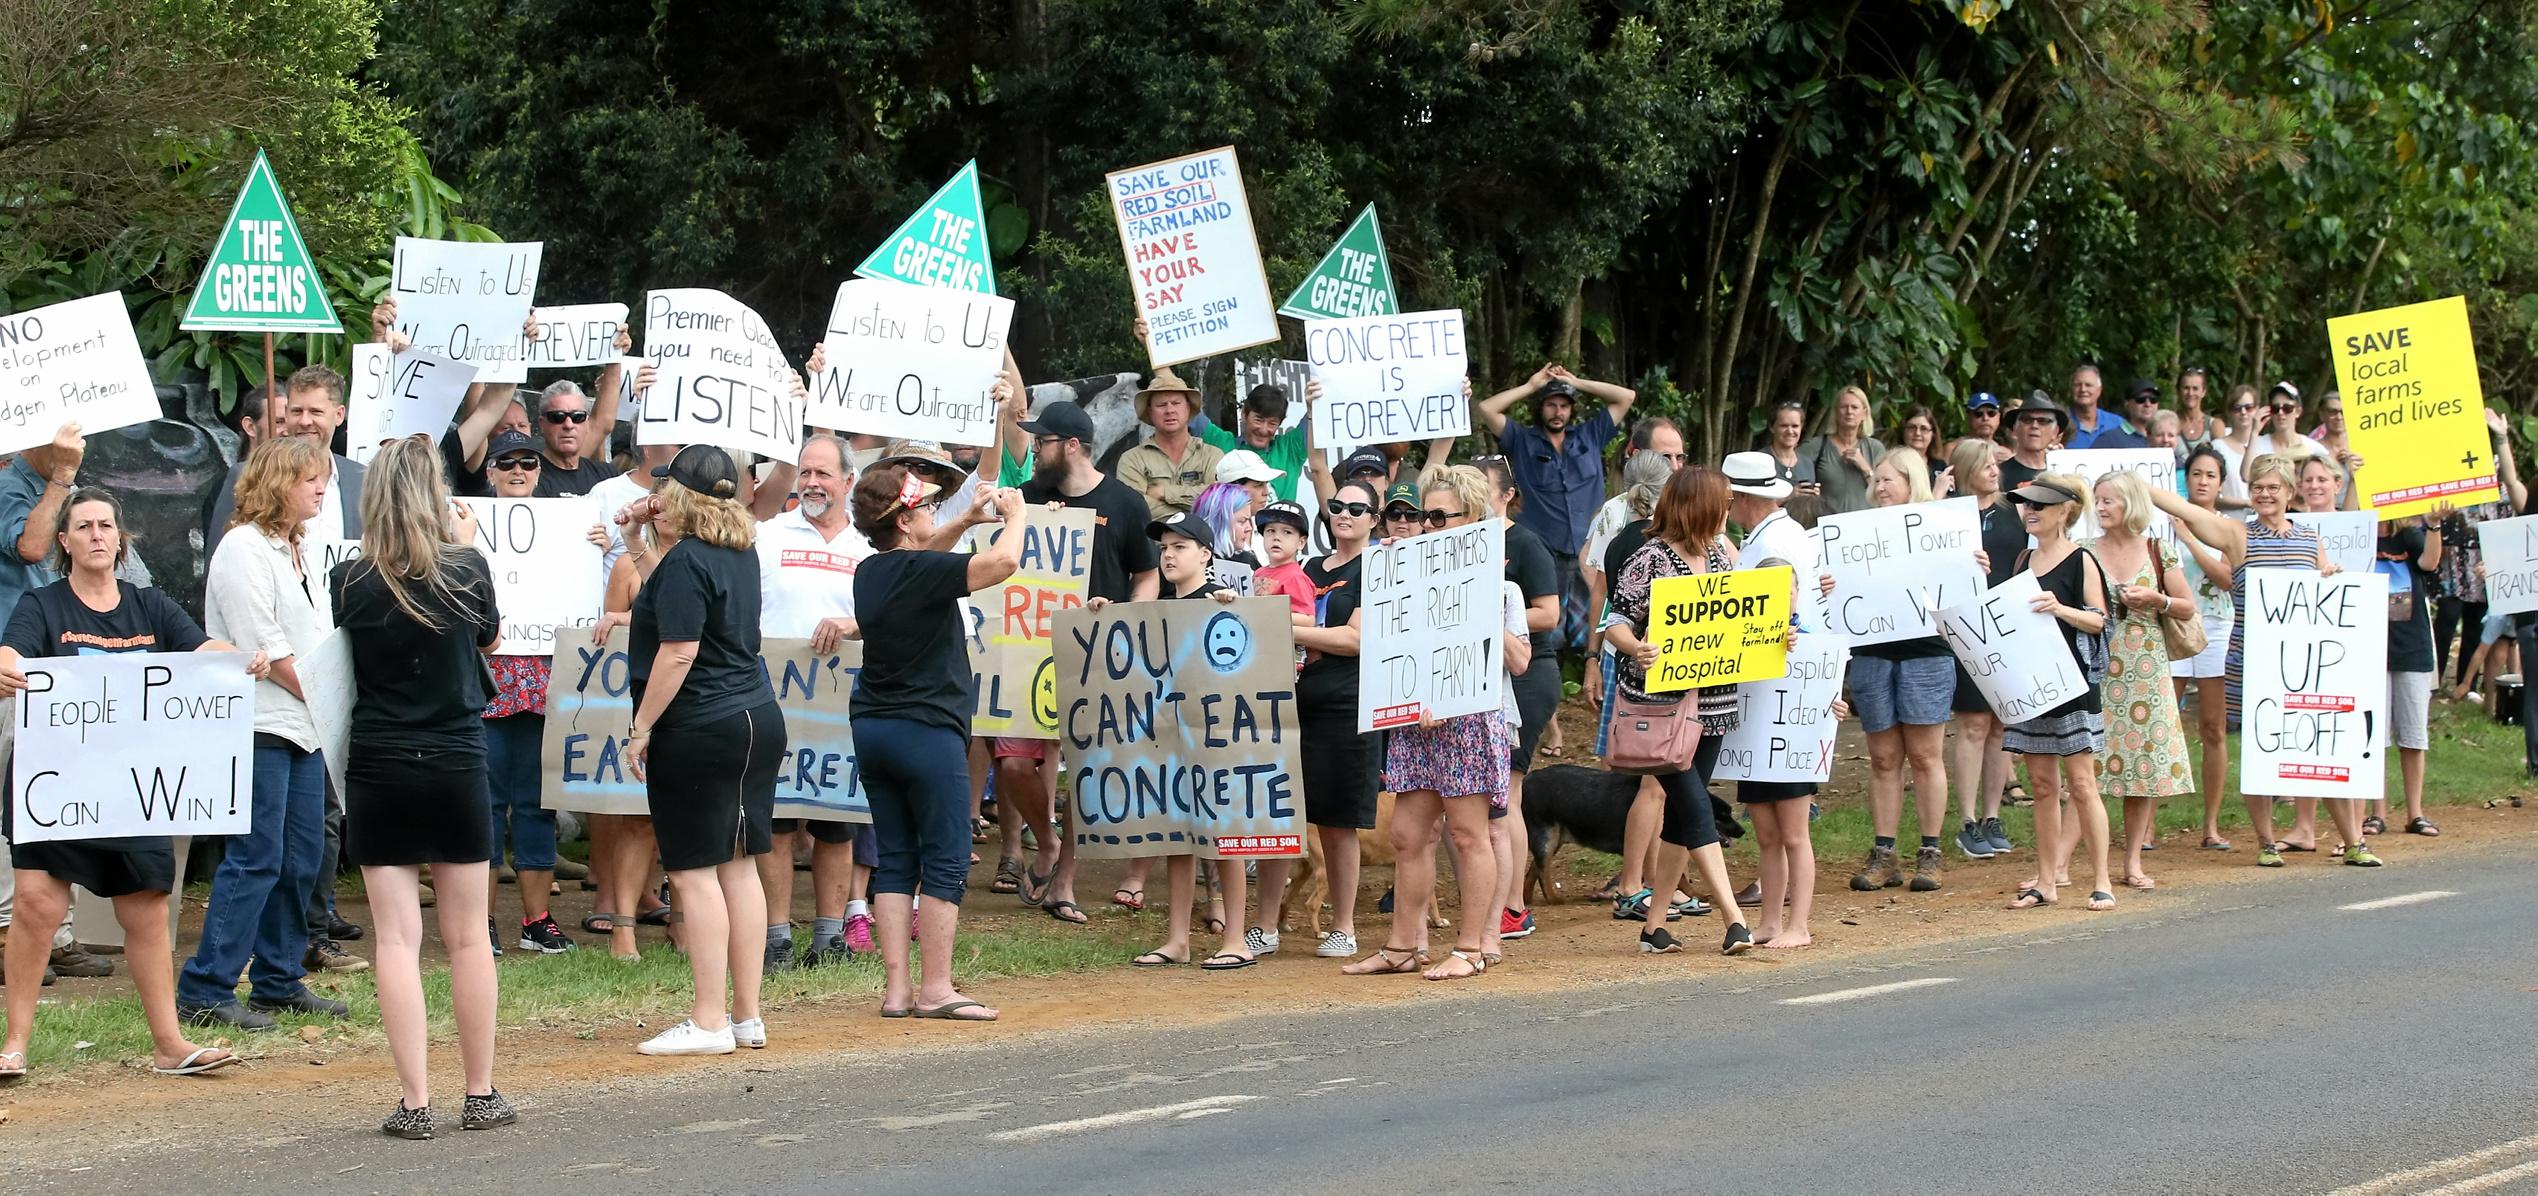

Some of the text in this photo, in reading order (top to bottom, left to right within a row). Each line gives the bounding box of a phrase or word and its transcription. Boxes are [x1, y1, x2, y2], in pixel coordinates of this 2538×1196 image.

[1117, 158, 1226, 196] SAVE OUR
[1124, 184, 1212, 217] RED SOIL
[929, 208, 976, 253] THE
[1128, 201, 1231, 240] FARMLAND
[239, 219, 283, 262] THE
[1134, 232, 1198, 263] HAVE
[893, 236, 983, 292] GREENS
[1139, 256, 1204, 287] YOUR
[1339, 247, 1377, 284] THE
[215, 263, 307, 314] GREENS
[1145, 283, 1184, 310] SAY
[1311, 275, 1386, 316] GREENS
[649, 295, 734, 332] Premier
[1152, 296, 1238, 329] PLEASE SIGN
[1155, 316, 1229, 346] PETITION
[0, 317, 43, 347] NO
[528, 321, 621, 361] REVER
[1309, 319, 1460, 366] CONCRETE
[2346, 327, 2411, 356] SAVE
[21, 374, 40, 386] on
[367, 354, 435, 400] SAVE
[649, 344, 783, 382] you need to
[1381, 366, 1405, 392] IS
[2352, 353, 2408, 381] local
[0, 381, 128, 426] dgen Plateau
[643, 375, 795, 445] LISTEN
[2356, 380, 2422, 406] farms
[1331, 394, 1467, 440] FOREVER!
[2360, 399, 2462, 430] and lives
[468, 503, 535, 553] NO
[2318, 520, 2370, 558] ospital
[782, 551, 807, 561] SAVE
[808, 552, 828, 562] OUR
[831, 556, 850, 566] RED
[1367, 528, 1488, 592] GIVE THE FARMERS
[1697, 575, 1731, 597] WE
[2259, 578, 2361, 628] WAKE
[1374, 578, 1475, 638] THE RIGHT
[1665, 595, 1769, 626] SUPPORT
[1662, 633, 1724, 654] a new
[1741, 633, 1784, 647] farmland!
[1743, 620, 1783, 638] Stay off
[1073, 618, 1173, 687] YOU
[1661, 653, 1742, 683] hospital
[2280, 639, 2346, 693] UP
[1382, 654, 1417, 706] TO
[1068, 680, 1293, 750] CAN'T EAT
[2255, 697, 2351, 756] GEOFF
[1076, 763, 1295, 825] CONCRETE
[1219, 837, 1299, 848] SAVE OUR RED SOIL
